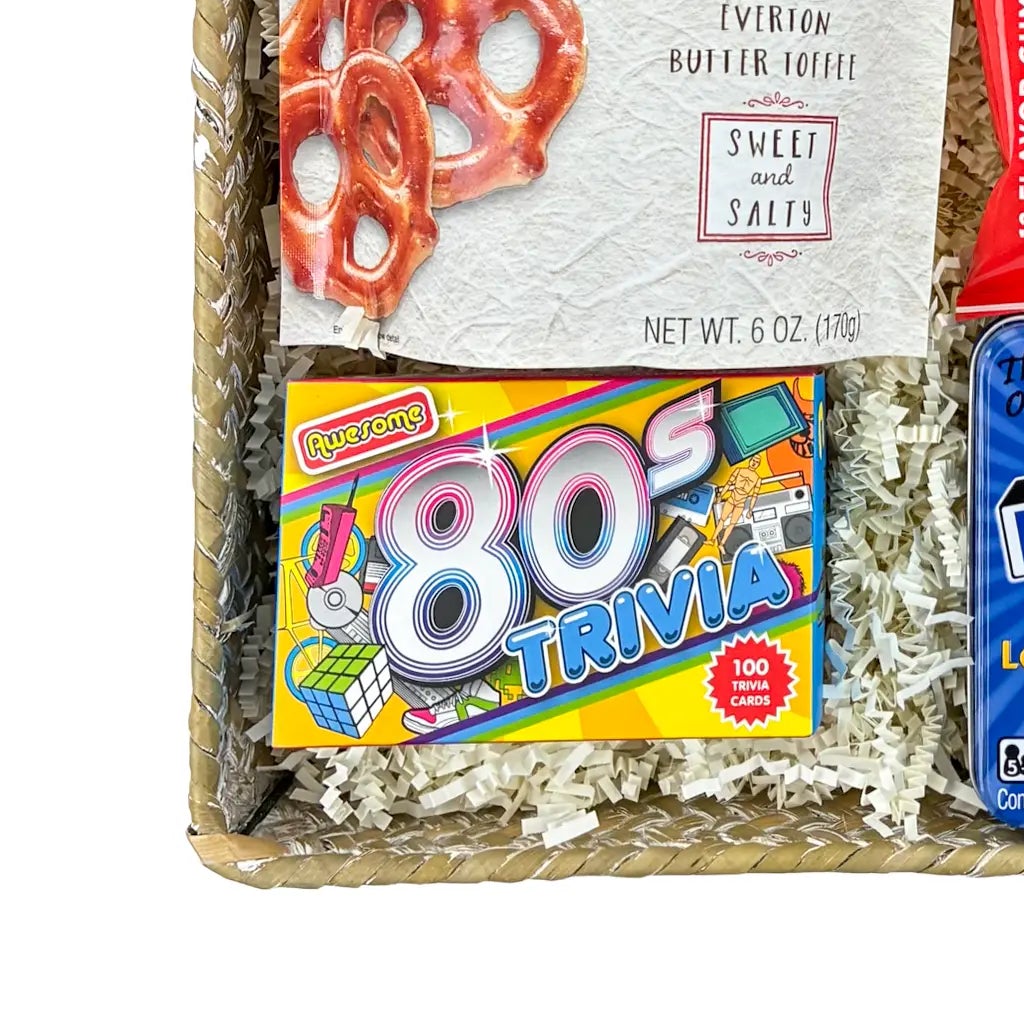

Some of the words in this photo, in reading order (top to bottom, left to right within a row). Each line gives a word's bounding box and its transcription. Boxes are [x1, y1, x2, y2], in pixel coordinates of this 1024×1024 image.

[720, 3, 831, 36] EVERTON
[669, 48, 768, 76] BUTTER
[784, 50, 857, 81] TOFFEE
[727, 128, 817, 160] SWEET
[750, 163, 794, 186] and
[727, 198, 813, 228] SALTY
[644, 314, 695, 345] NET
[700, 314, 742, 345] WT.
[750, 314, 765, 345] 6
[773, 314, 808, 344] OZ.
[815, 309, 861, 345] (170g)
[306, 403, 425, 459] Awesome
[506, 540, 793, 698] TRIVIA
[732, 658, 770, 677] 100
[730, 695, 772, 707] CARDS
[731, 680, 770, 692] TRIVIA
